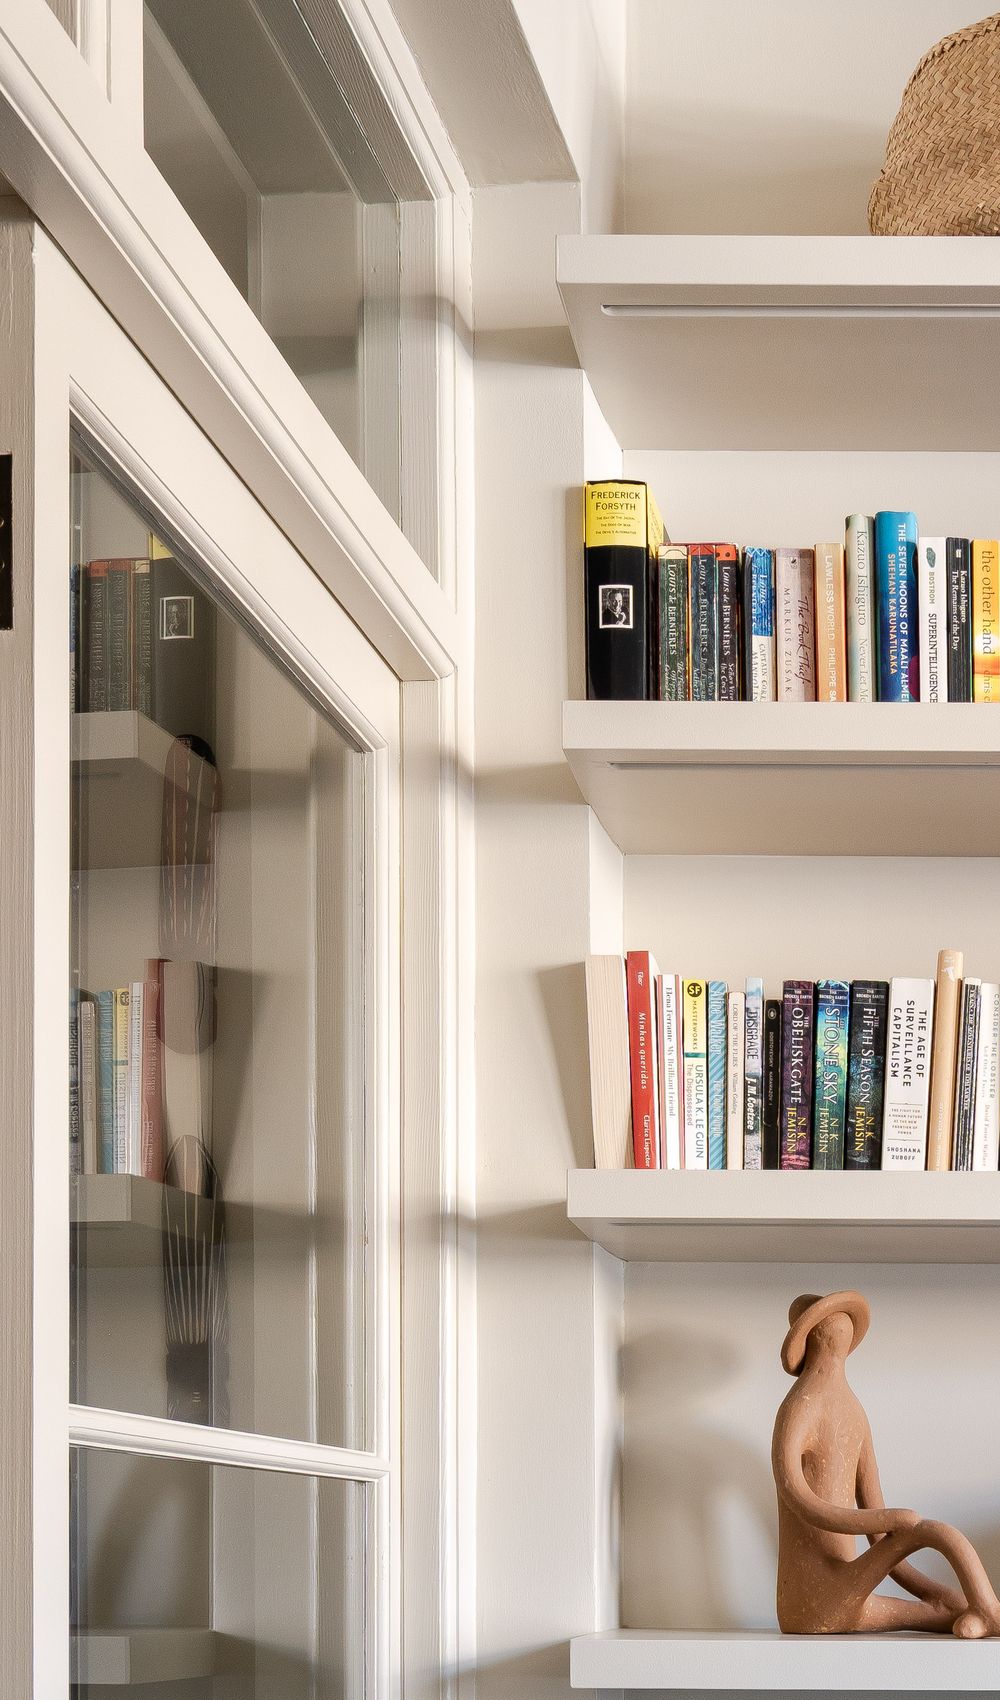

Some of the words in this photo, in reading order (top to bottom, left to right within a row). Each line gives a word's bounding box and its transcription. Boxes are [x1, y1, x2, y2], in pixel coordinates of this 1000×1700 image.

[591, 490, 641, 500] FREDERICK
[595, 501, 636, 511] FORSYTH
[888, 554, 896, 594] SHEHAN
[982, 551, 994, 572] the
[958, 594, 967, 623] Ishiguro
[982, 577, 994, 615] other
[889, 598, 897, 674] KARUNATILAKA
[982, 618, 995, 655] hand
[983, 670, 994, 693] chris
[791, 1007, 803, 1066] OBELISK
[823, 1008, 840, 1066] STONE
[862, 1008, 876, 1045] FIFTH
[917, 1009, 927, 1032] THE
[890, 1008, 902, 1078] CAPITALISM
[902, 1000, 915, 1087] SURVEILLANCE
[916, 1036, 925, 1059] AGE
[695, 1065, 703, 1105] URSULA
[790, 1069, 801, 1104] GATE
[823, 1072, 838, 1104] SKY
[859, 1048, 874, 1103] SEASON
[916, 1064, 924, 1078] OF
[695, 1107, 703, 1117] K.
[695, 1119, 703, 1129] LE
[786, 1107, 796, 1152] JEMISIN
[819, 1108, 829, 1153] JEMISIN
[855, 1106, 866, 1151] JEMISIN
[695, 1132, 704, 1158] GUIN
